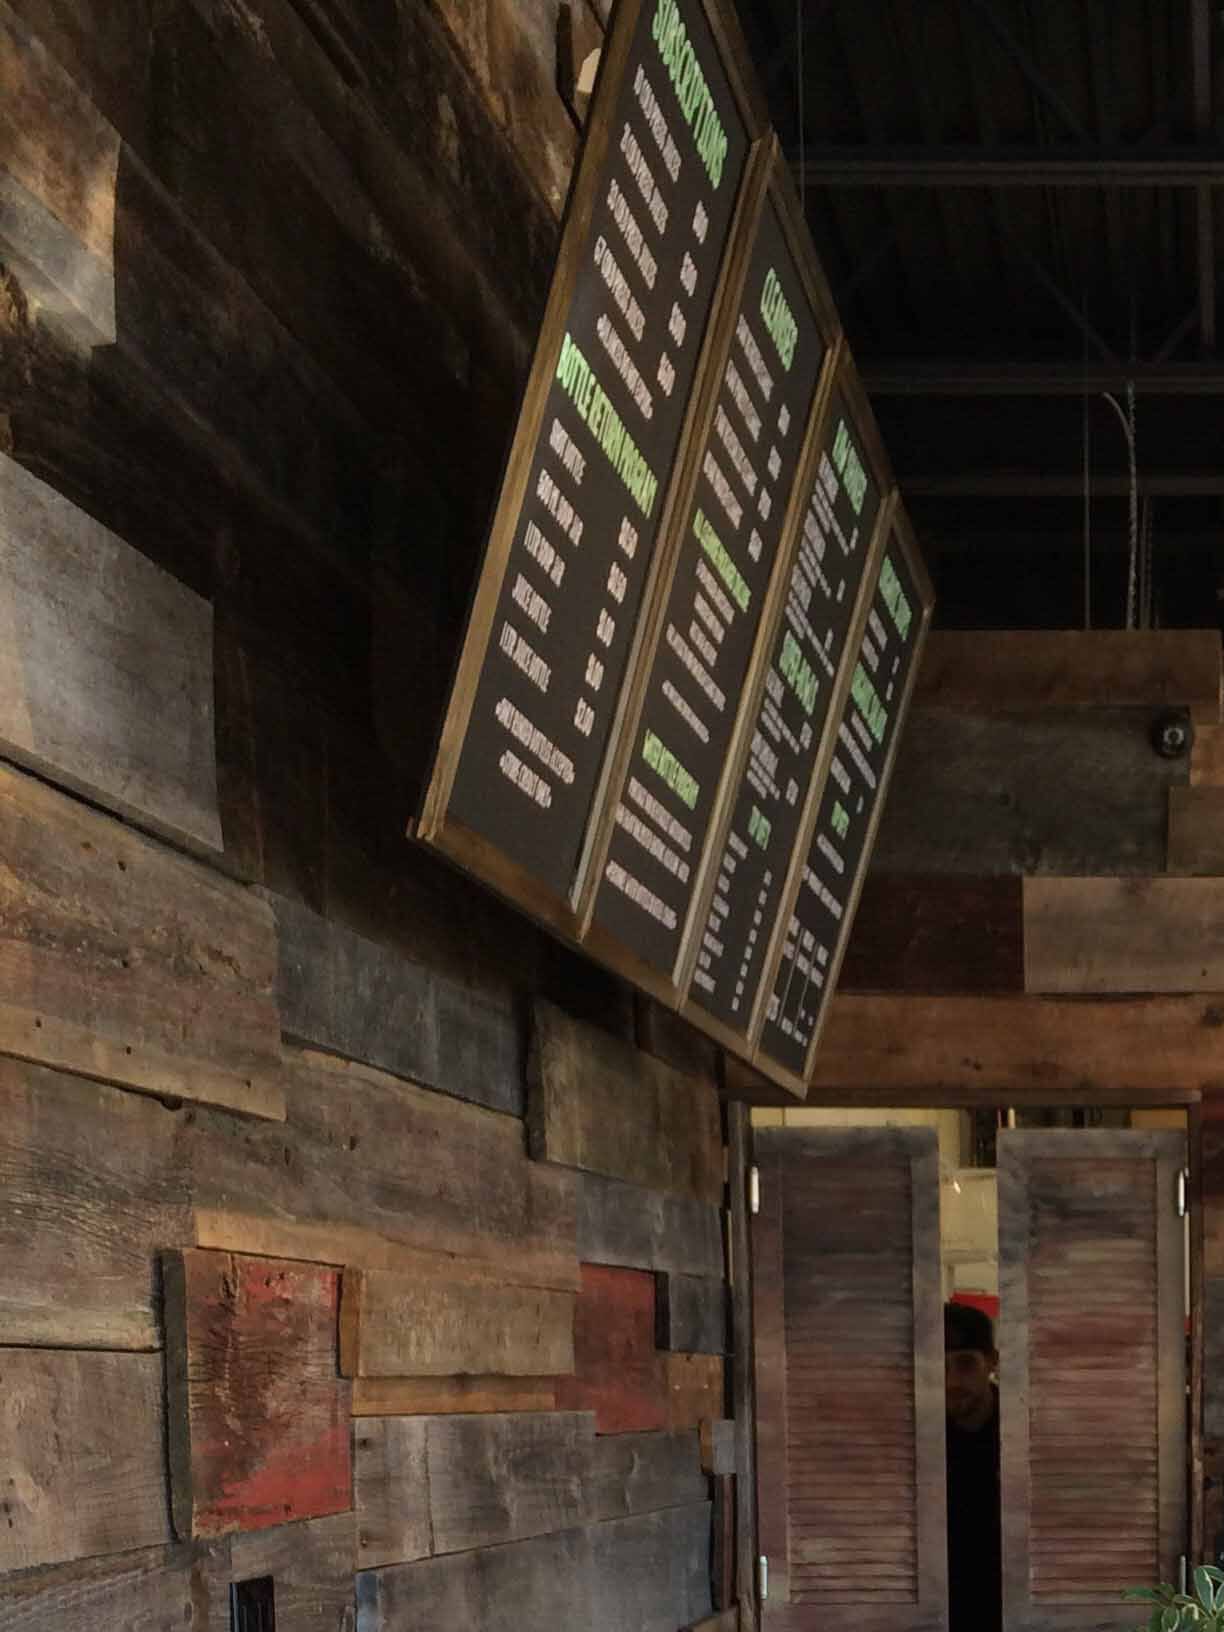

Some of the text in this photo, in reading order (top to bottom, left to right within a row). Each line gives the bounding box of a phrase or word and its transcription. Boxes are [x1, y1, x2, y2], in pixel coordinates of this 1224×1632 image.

[761, 268, 797, 371] CLEANSES
[557, 333, 657, 518] BOTTLE RETURN PROGRAM
